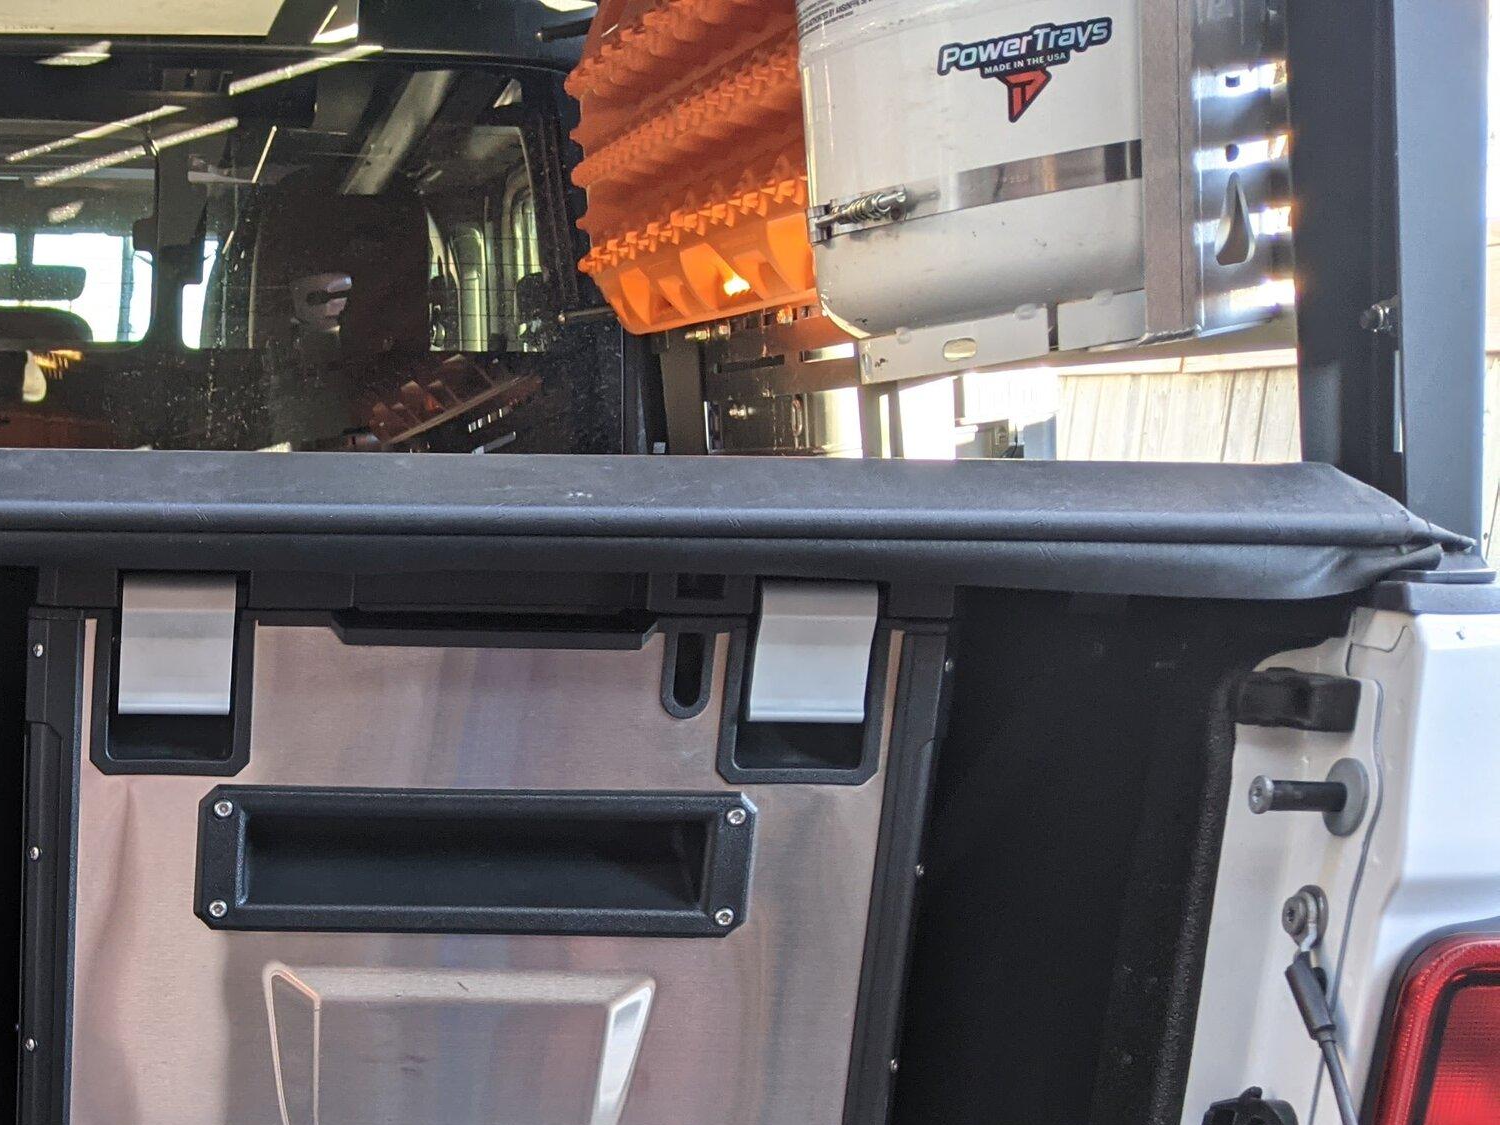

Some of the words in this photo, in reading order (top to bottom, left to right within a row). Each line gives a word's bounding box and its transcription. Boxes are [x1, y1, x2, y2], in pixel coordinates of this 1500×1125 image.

[941, 21, 1108, 71] PowerTrays
[984, 63, 1011, 74] MADE
[1013, 60, 1025, 69] IN
[1027, 57, 1045, 66] THE
[1047, 52, 1067, 62] USA
